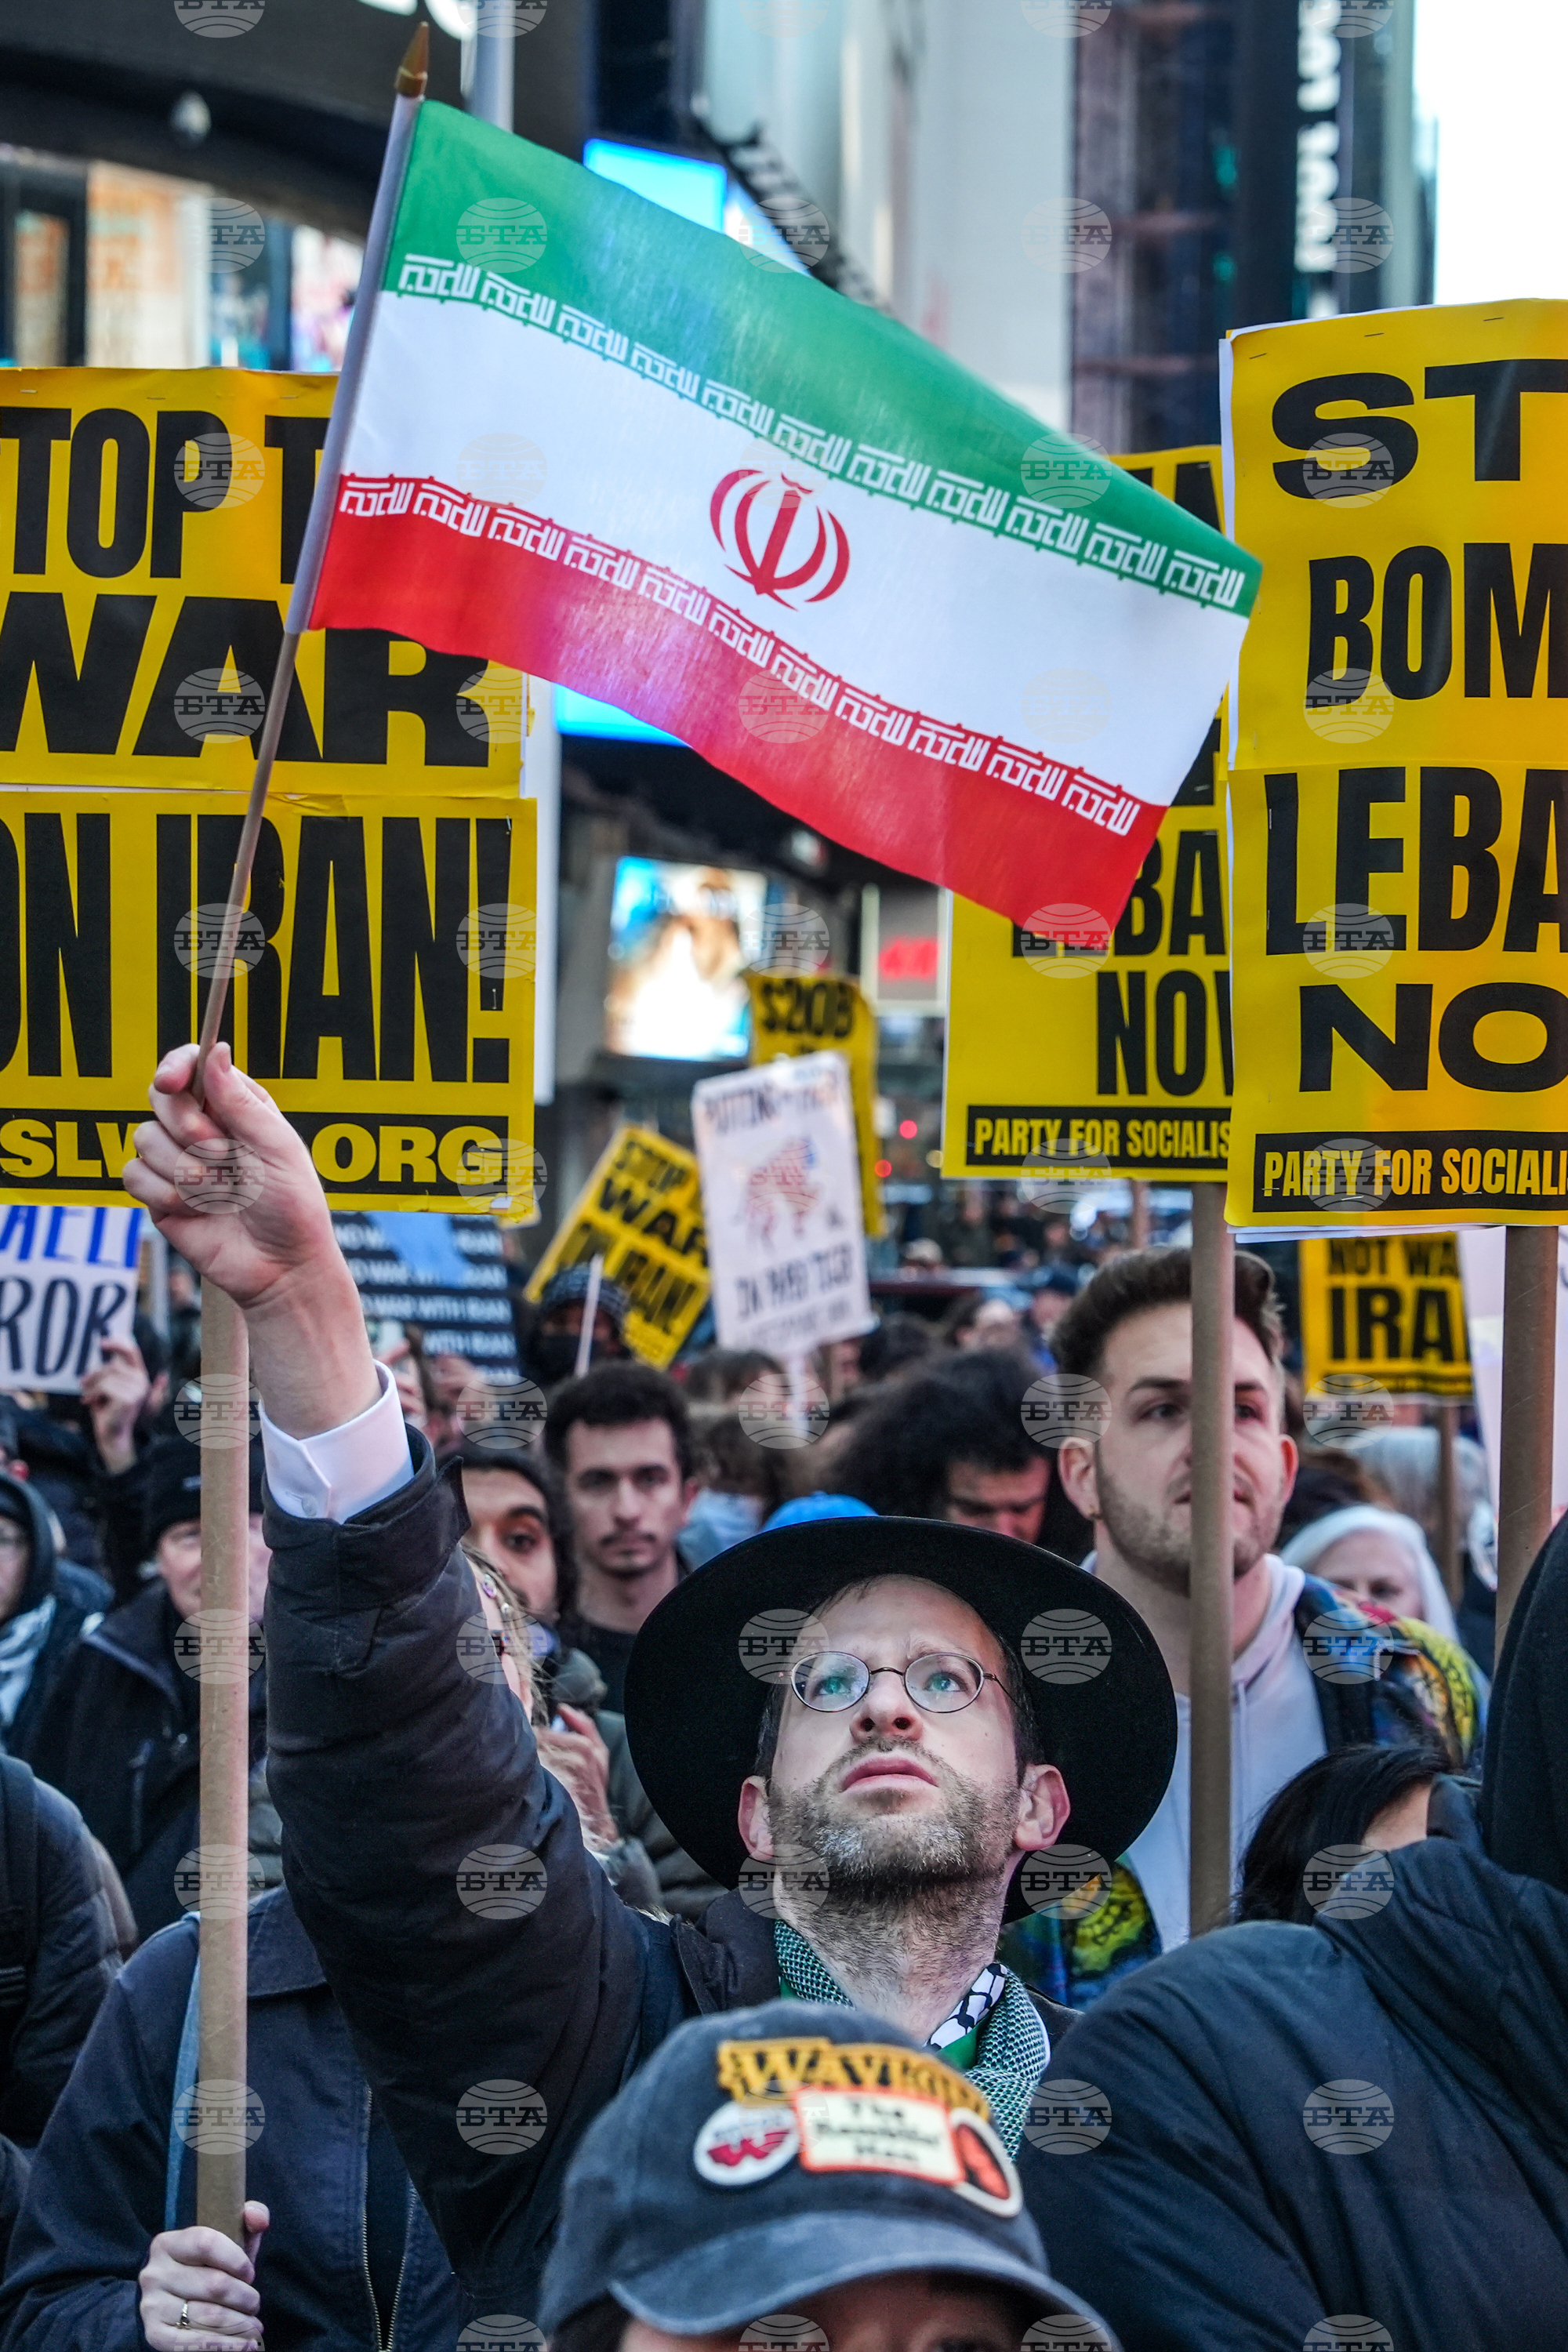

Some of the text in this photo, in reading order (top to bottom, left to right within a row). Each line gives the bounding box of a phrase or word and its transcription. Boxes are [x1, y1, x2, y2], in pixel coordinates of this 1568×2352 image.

[1273, 358, 1568, 499] ST
[0, 591, 489, 768] WAR
[1306, 543, 1568, 709] BOM
[1264, 766, 1568, 956] LEBA
[157, 813, 514, 1084] IRAN!
[1298, 982, 1568, 1093] NO
[975, 1117, 1062, 1156] PARTY
[1069, 1118, 1121, 1157] FOR
[1263, 1149, 1363, 1197] PARTY
[1373, 1149, 1433, 1196] FOR
[1330, 1286, 1469, 1363] IRA
